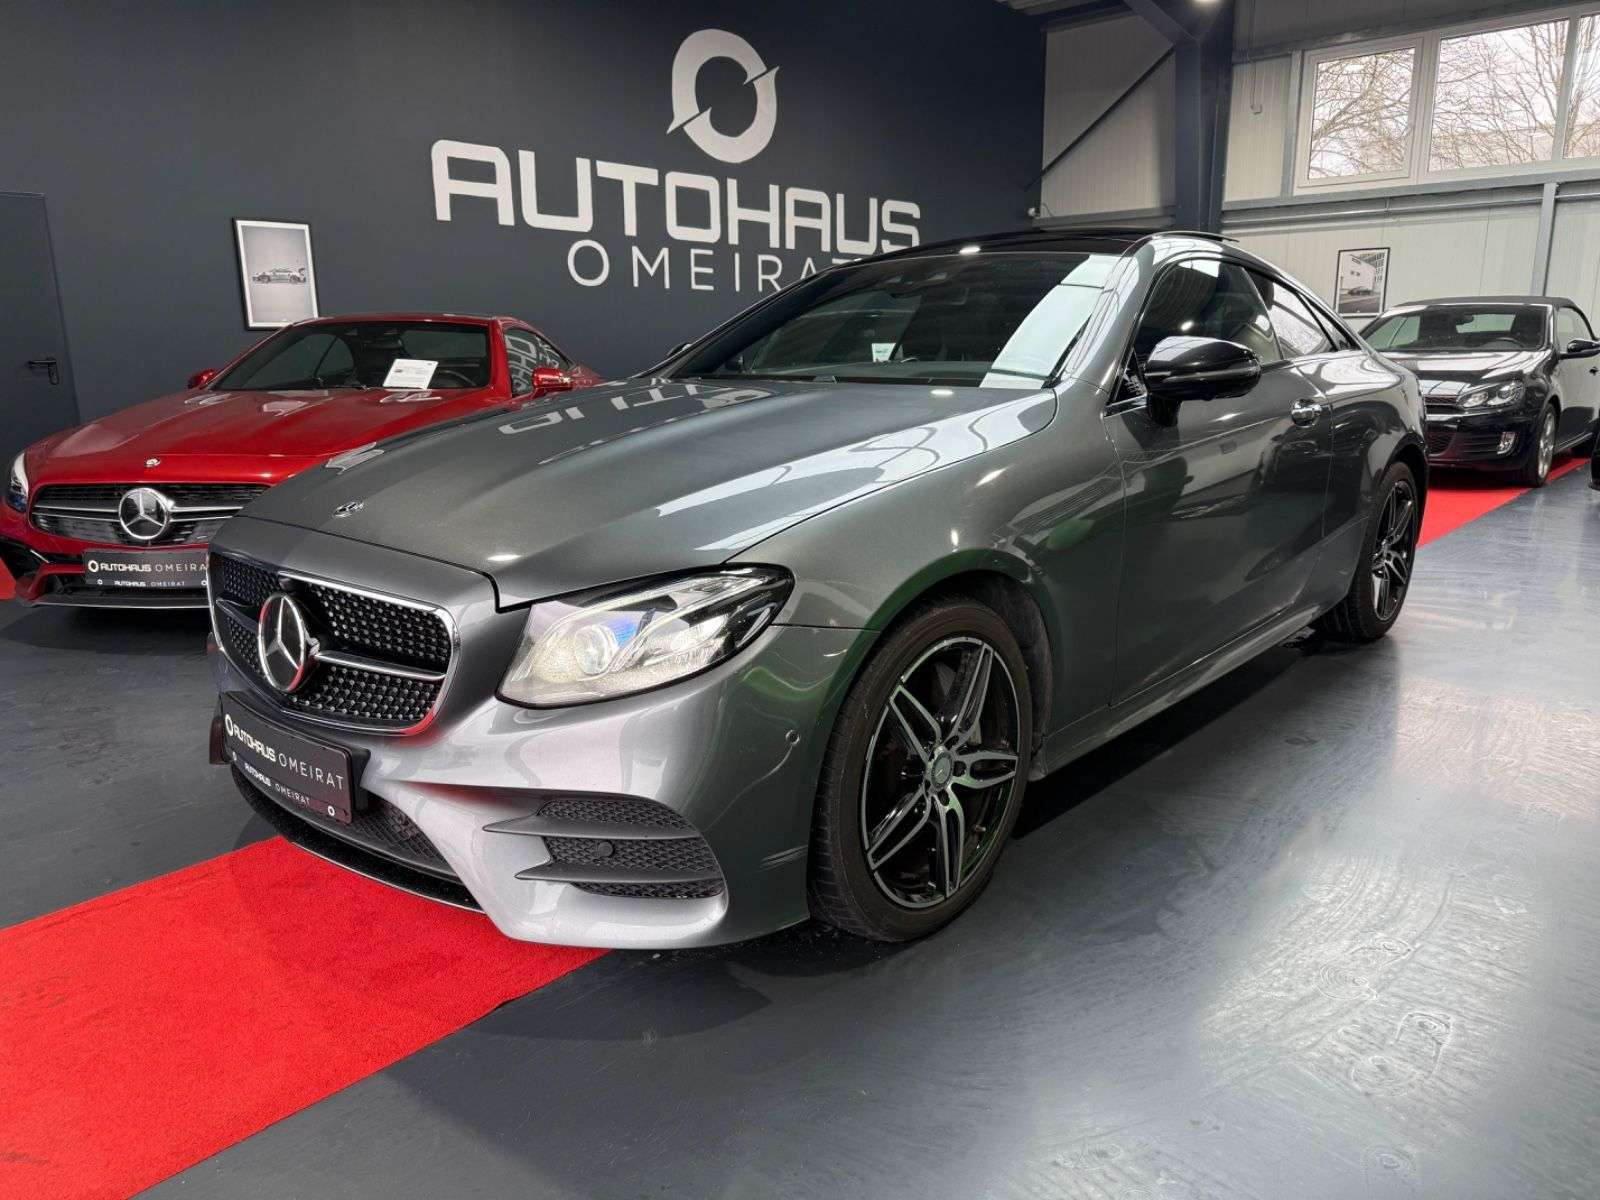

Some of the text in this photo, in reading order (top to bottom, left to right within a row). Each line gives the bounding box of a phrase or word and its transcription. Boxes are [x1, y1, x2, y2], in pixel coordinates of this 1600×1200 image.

[431, 139, 921, 255] AUTOHAUS
[100, 563, 152, 572] AUTOHAUS
[233, 725, 344, 791] AUTOHAUS OMEIRAT
[275, 783, 310, 806] OMEIRAT
